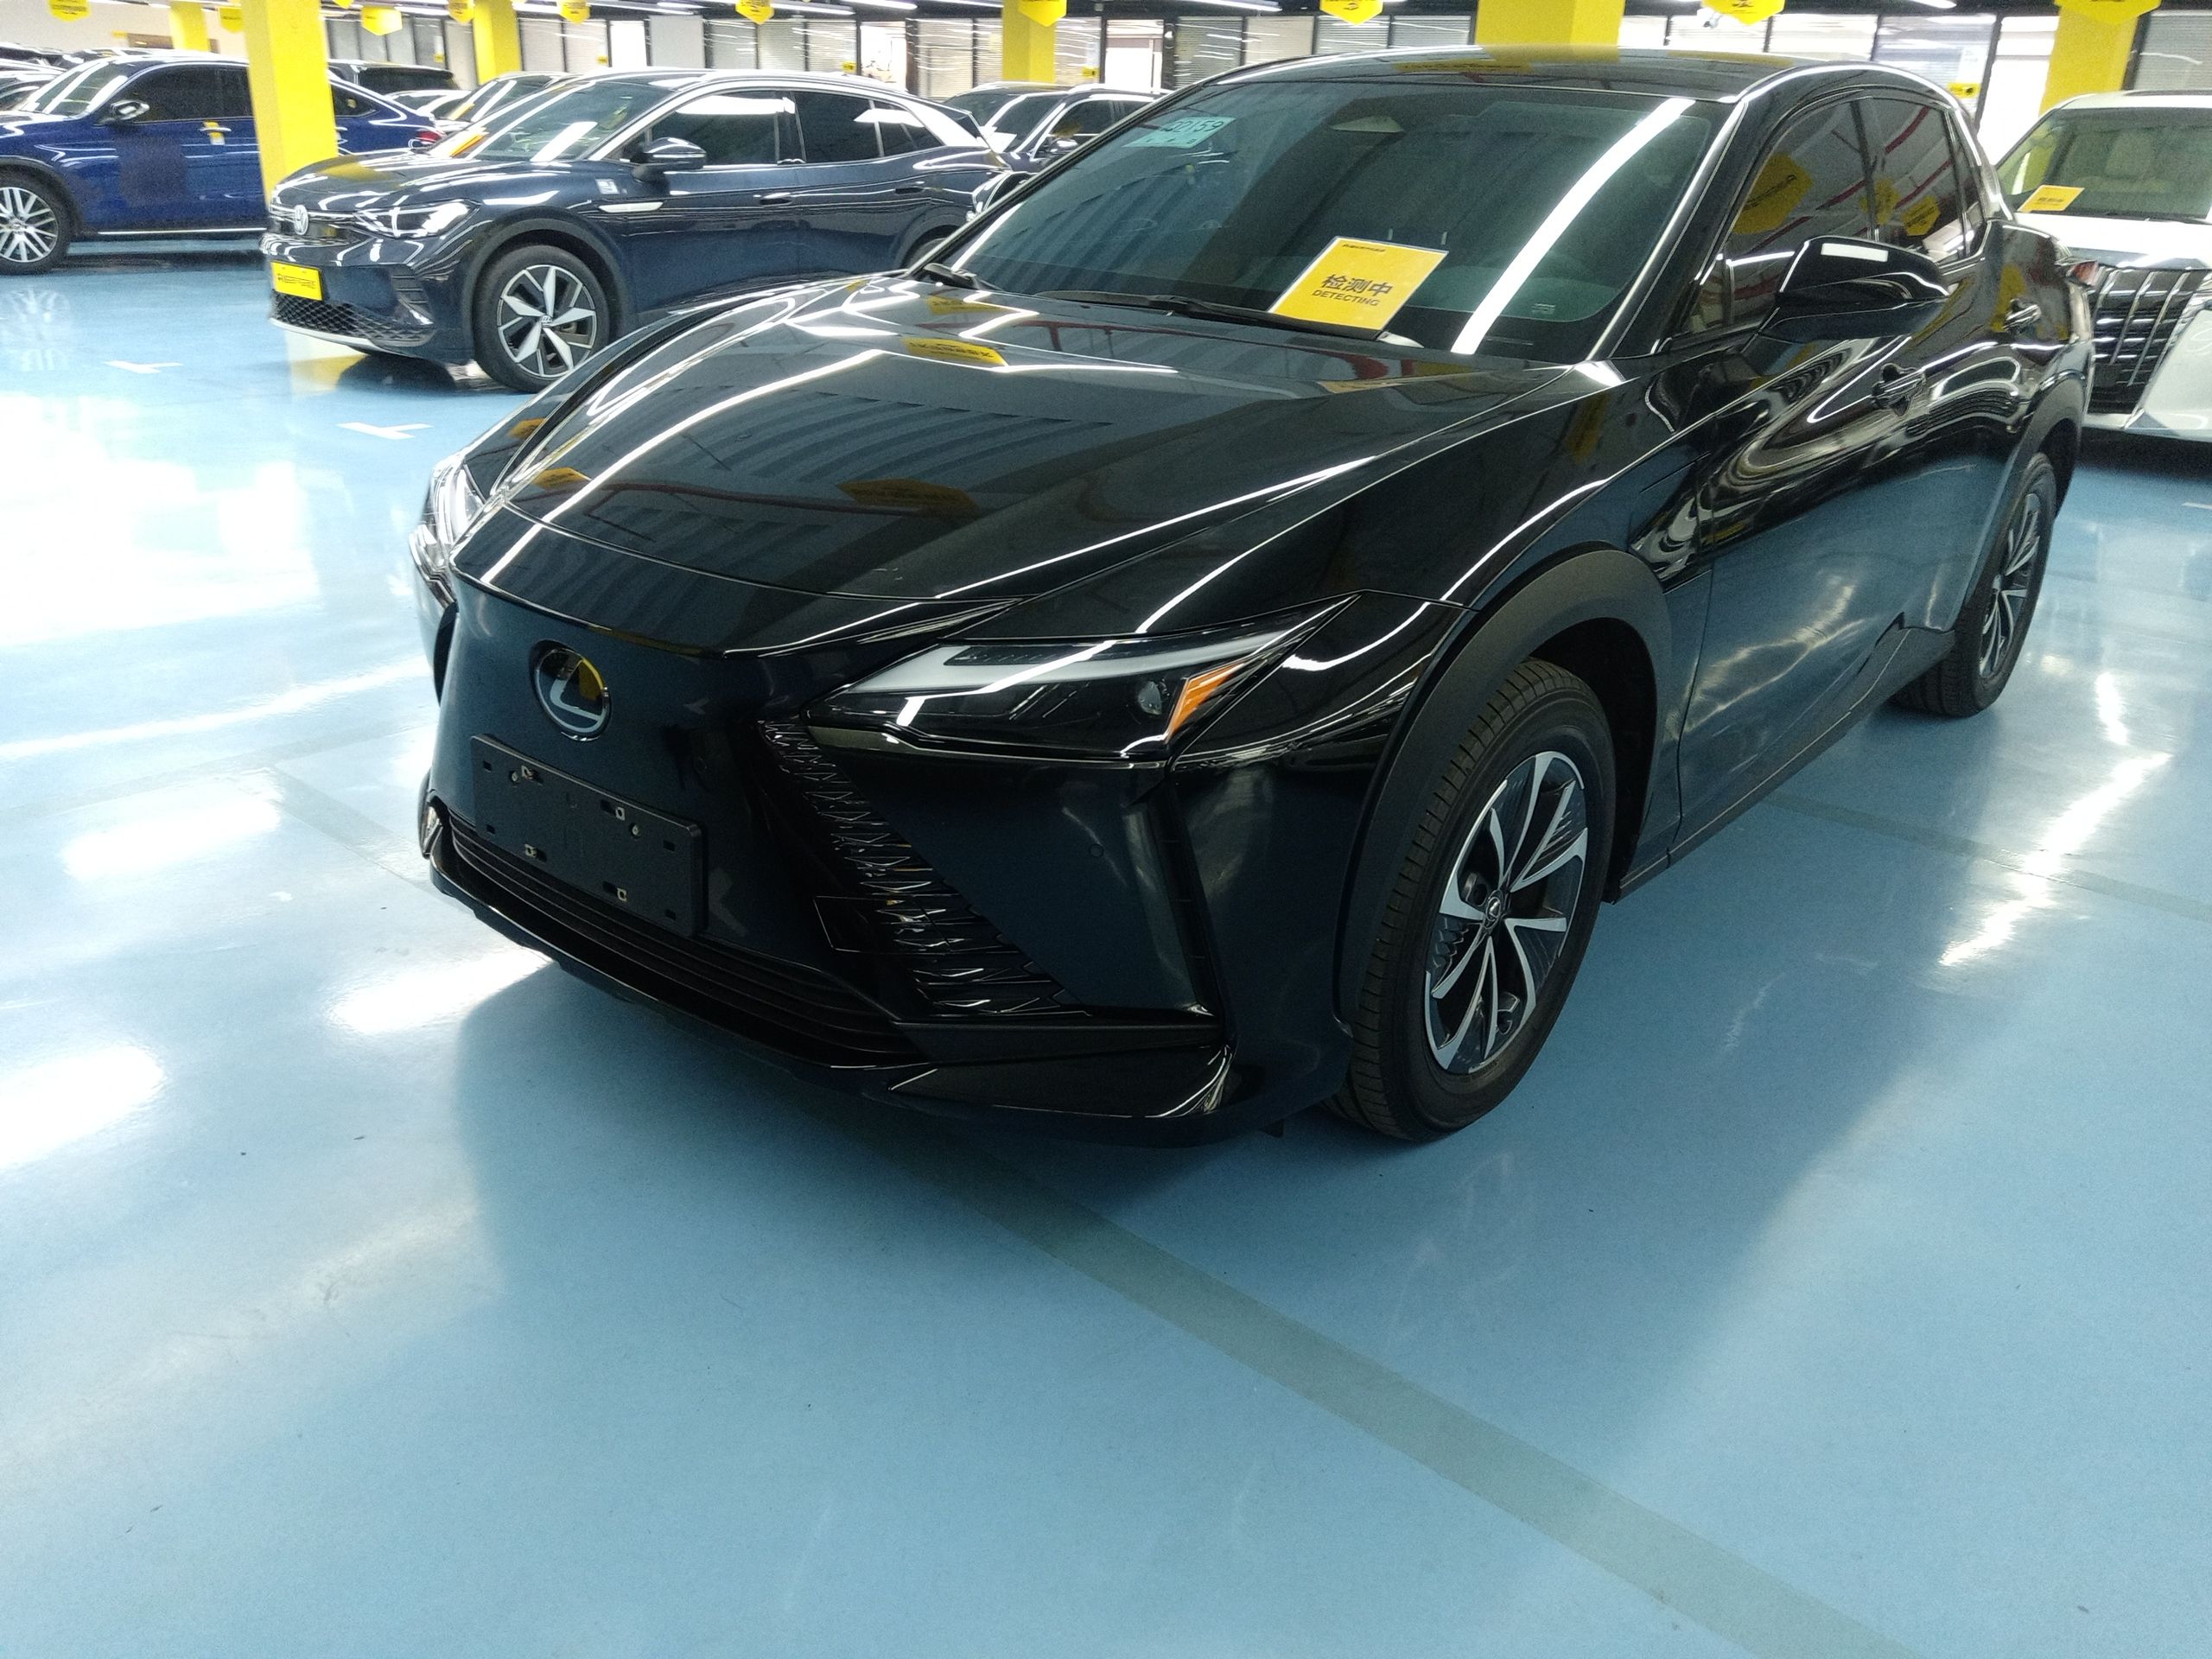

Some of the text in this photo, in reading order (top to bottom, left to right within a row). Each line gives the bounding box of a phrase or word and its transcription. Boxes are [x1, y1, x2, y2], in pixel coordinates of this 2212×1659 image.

[1321, 274, 1393, 296] 检测中
[1312, 289, 1380, 306] DETECTING
